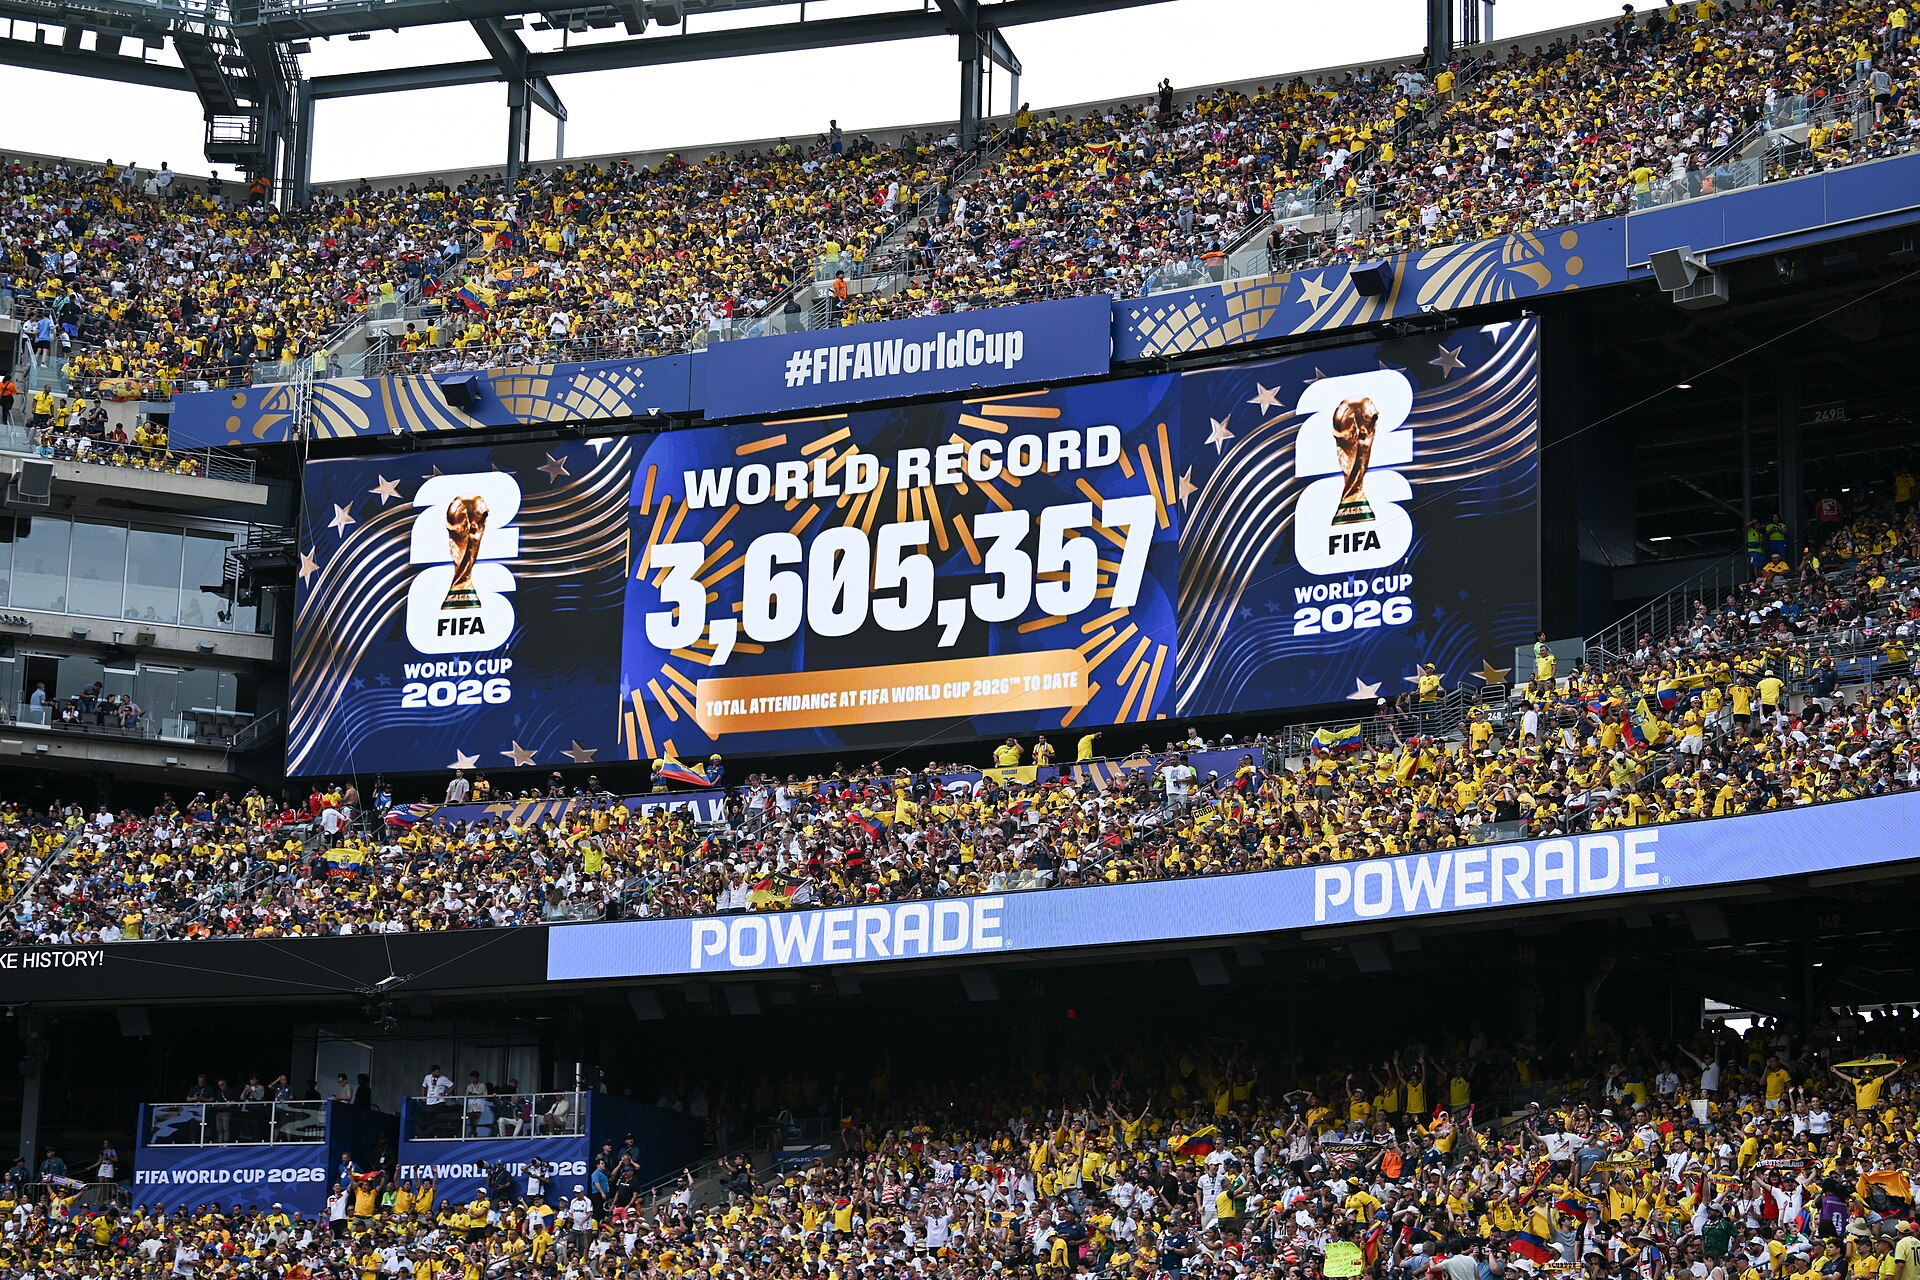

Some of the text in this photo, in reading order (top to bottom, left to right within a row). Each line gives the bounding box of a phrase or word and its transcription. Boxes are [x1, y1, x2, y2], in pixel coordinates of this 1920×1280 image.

[784, 328, 1024, 388] #FIFAWorldCup
[1815, 408, 1845, 423] 249B
[683, 425, 1122, 509] WORLD RECORD
[1328, 530, 1381, 556] FIFA
[645, 495, 1156, 667] 3,605,357
[1294, 574, 1413, 604] WORLD CUP
[437, 616, 485, 636] FIFA
[1293, 596, 1413, 636] 2026
[403, 658, 513, 679] WORLD CUP
[401, 678, 512, 708] 2026
[706, 699, 747, 717] TOTAL
[750, 692, 837, 714] ATTENDANCE
[839, 690, 857, 708] AT
[859, 687, 889, 706] FIFA
[891, 684, 940, 703] WORLD
[943, 681, 970, 699] CUP
[1023, 675, 1040, 692] TO
[1043, 671, 1078, 690] DATE
[1487, 711, 1502, 720] 248
[23, 950, 104, 969] HISTORY!
[135, 1167, 326, 1184] FIFA WORLD CUP 2026
[400, 1165, 433, 1180] FIFA
[547, 1161, 587, 1176] 026
